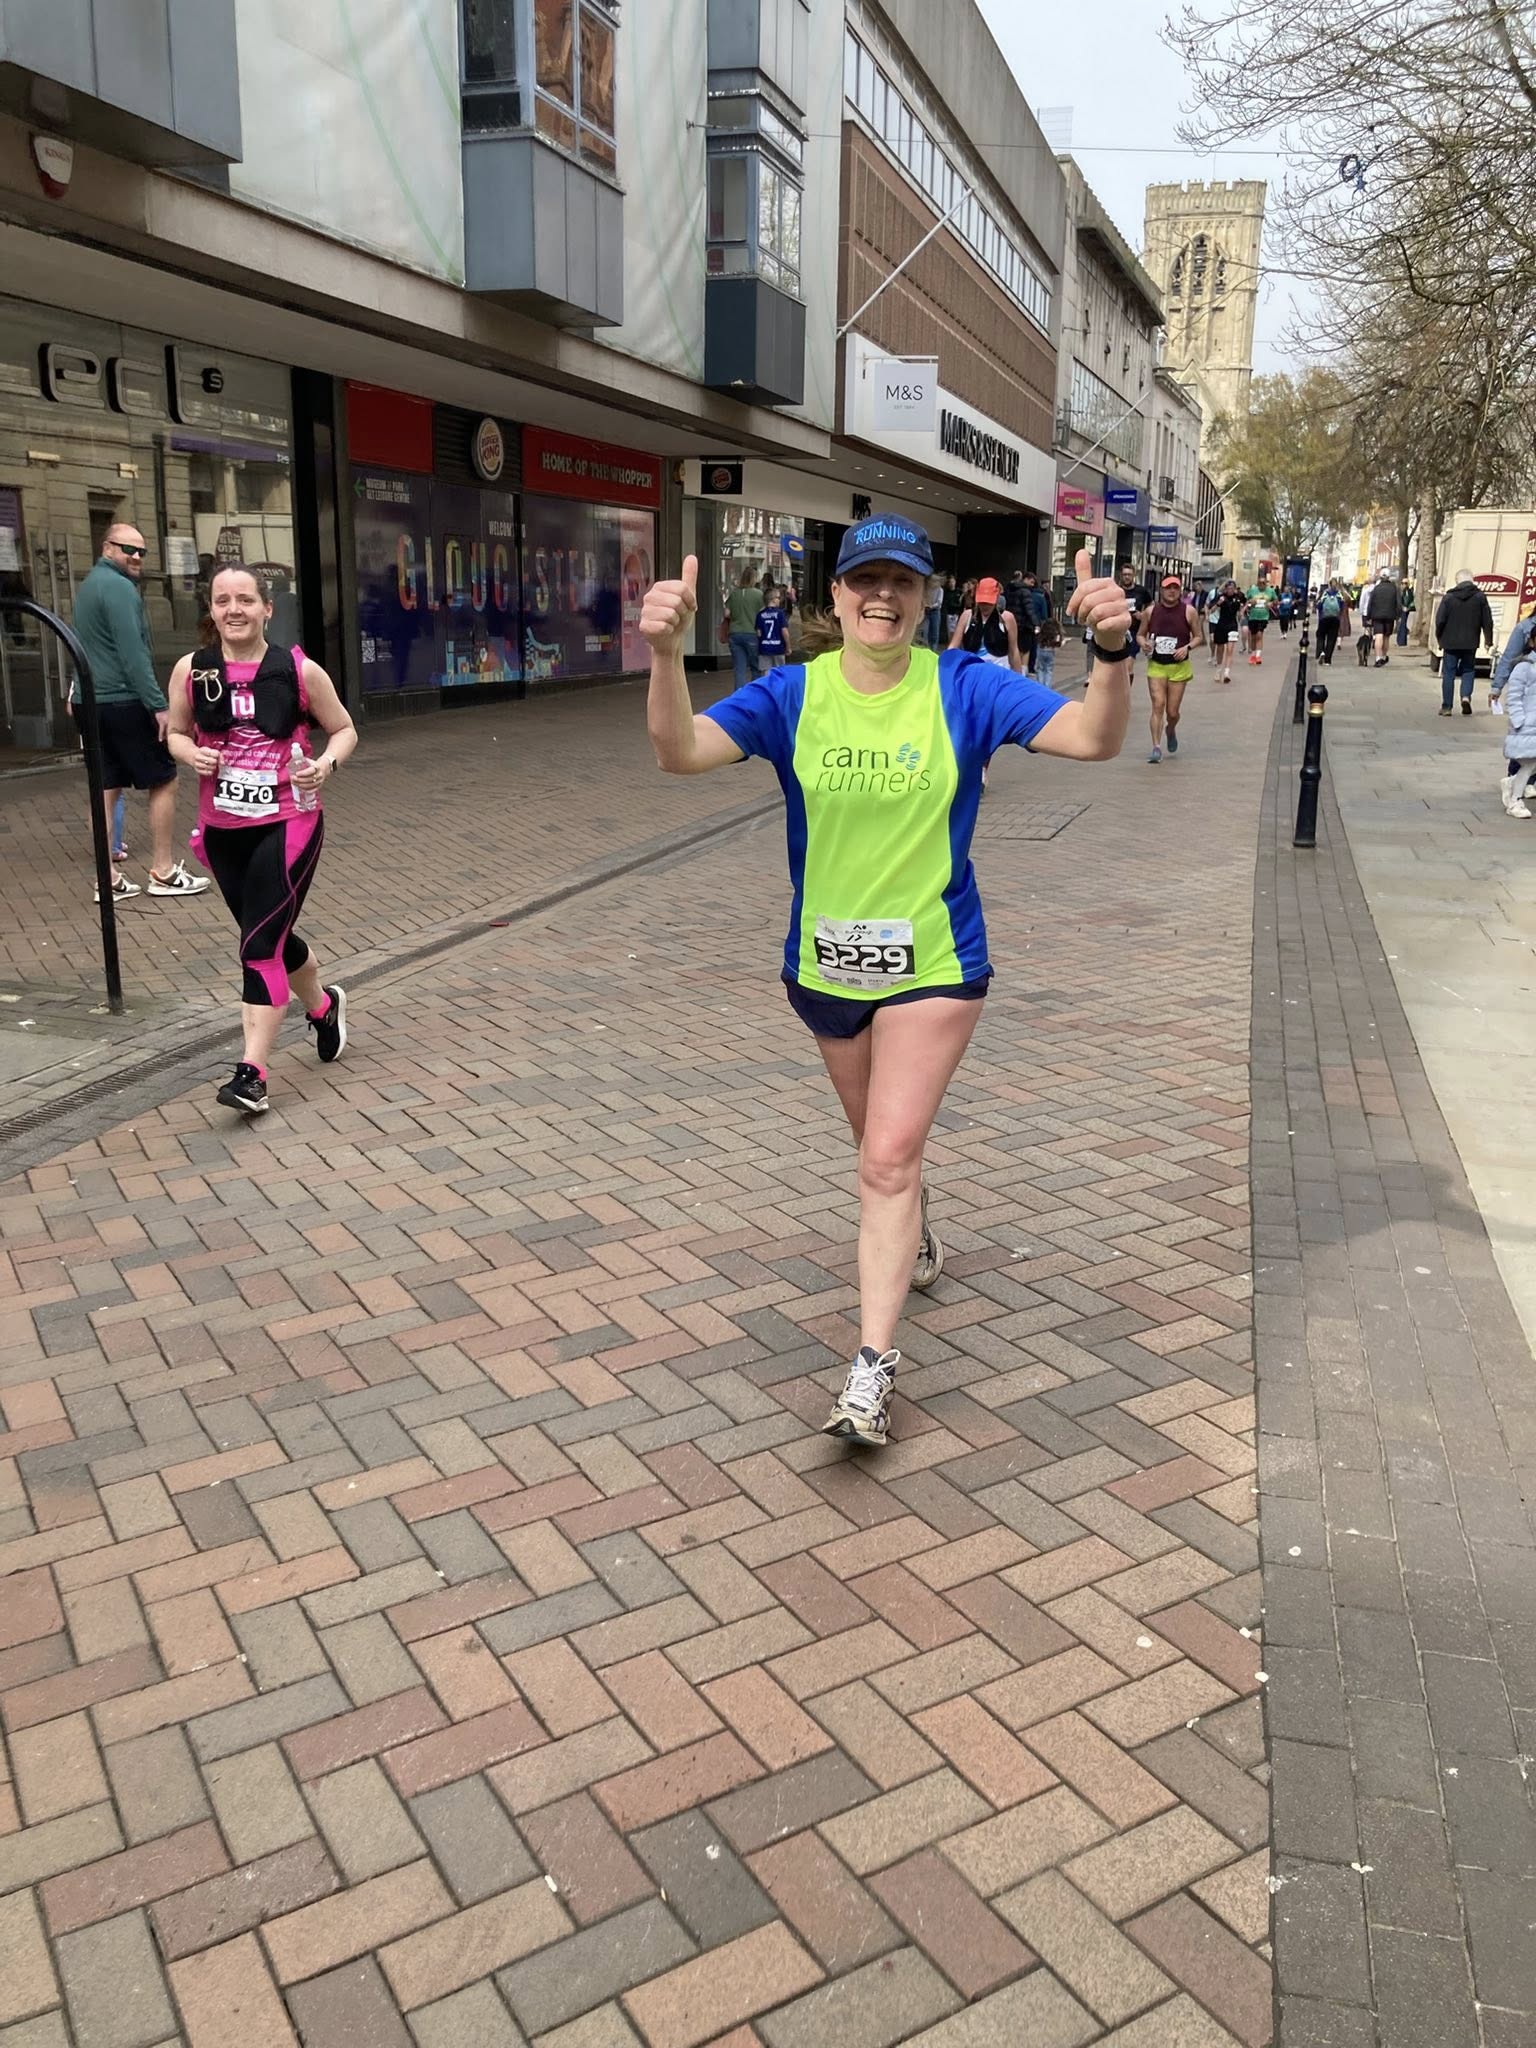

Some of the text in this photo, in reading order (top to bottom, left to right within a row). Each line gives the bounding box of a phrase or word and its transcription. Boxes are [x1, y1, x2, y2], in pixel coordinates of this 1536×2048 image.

[886, 385, 923, 401] M&S
[481, 434, 500, 448] BURGER
[481, 444, 500, 460] KING
[542, 451, 653, 489] HOME OF THE WHOPPER
[855, 524, 917, 546] RUNNING
[764, 620, 775, 639] 7
[822, 746, 889, 769] carn
[218, 780, 273, 804] 1970
[815, 769, 931, 793] runners
[818, 939, 908, 974] 3229
